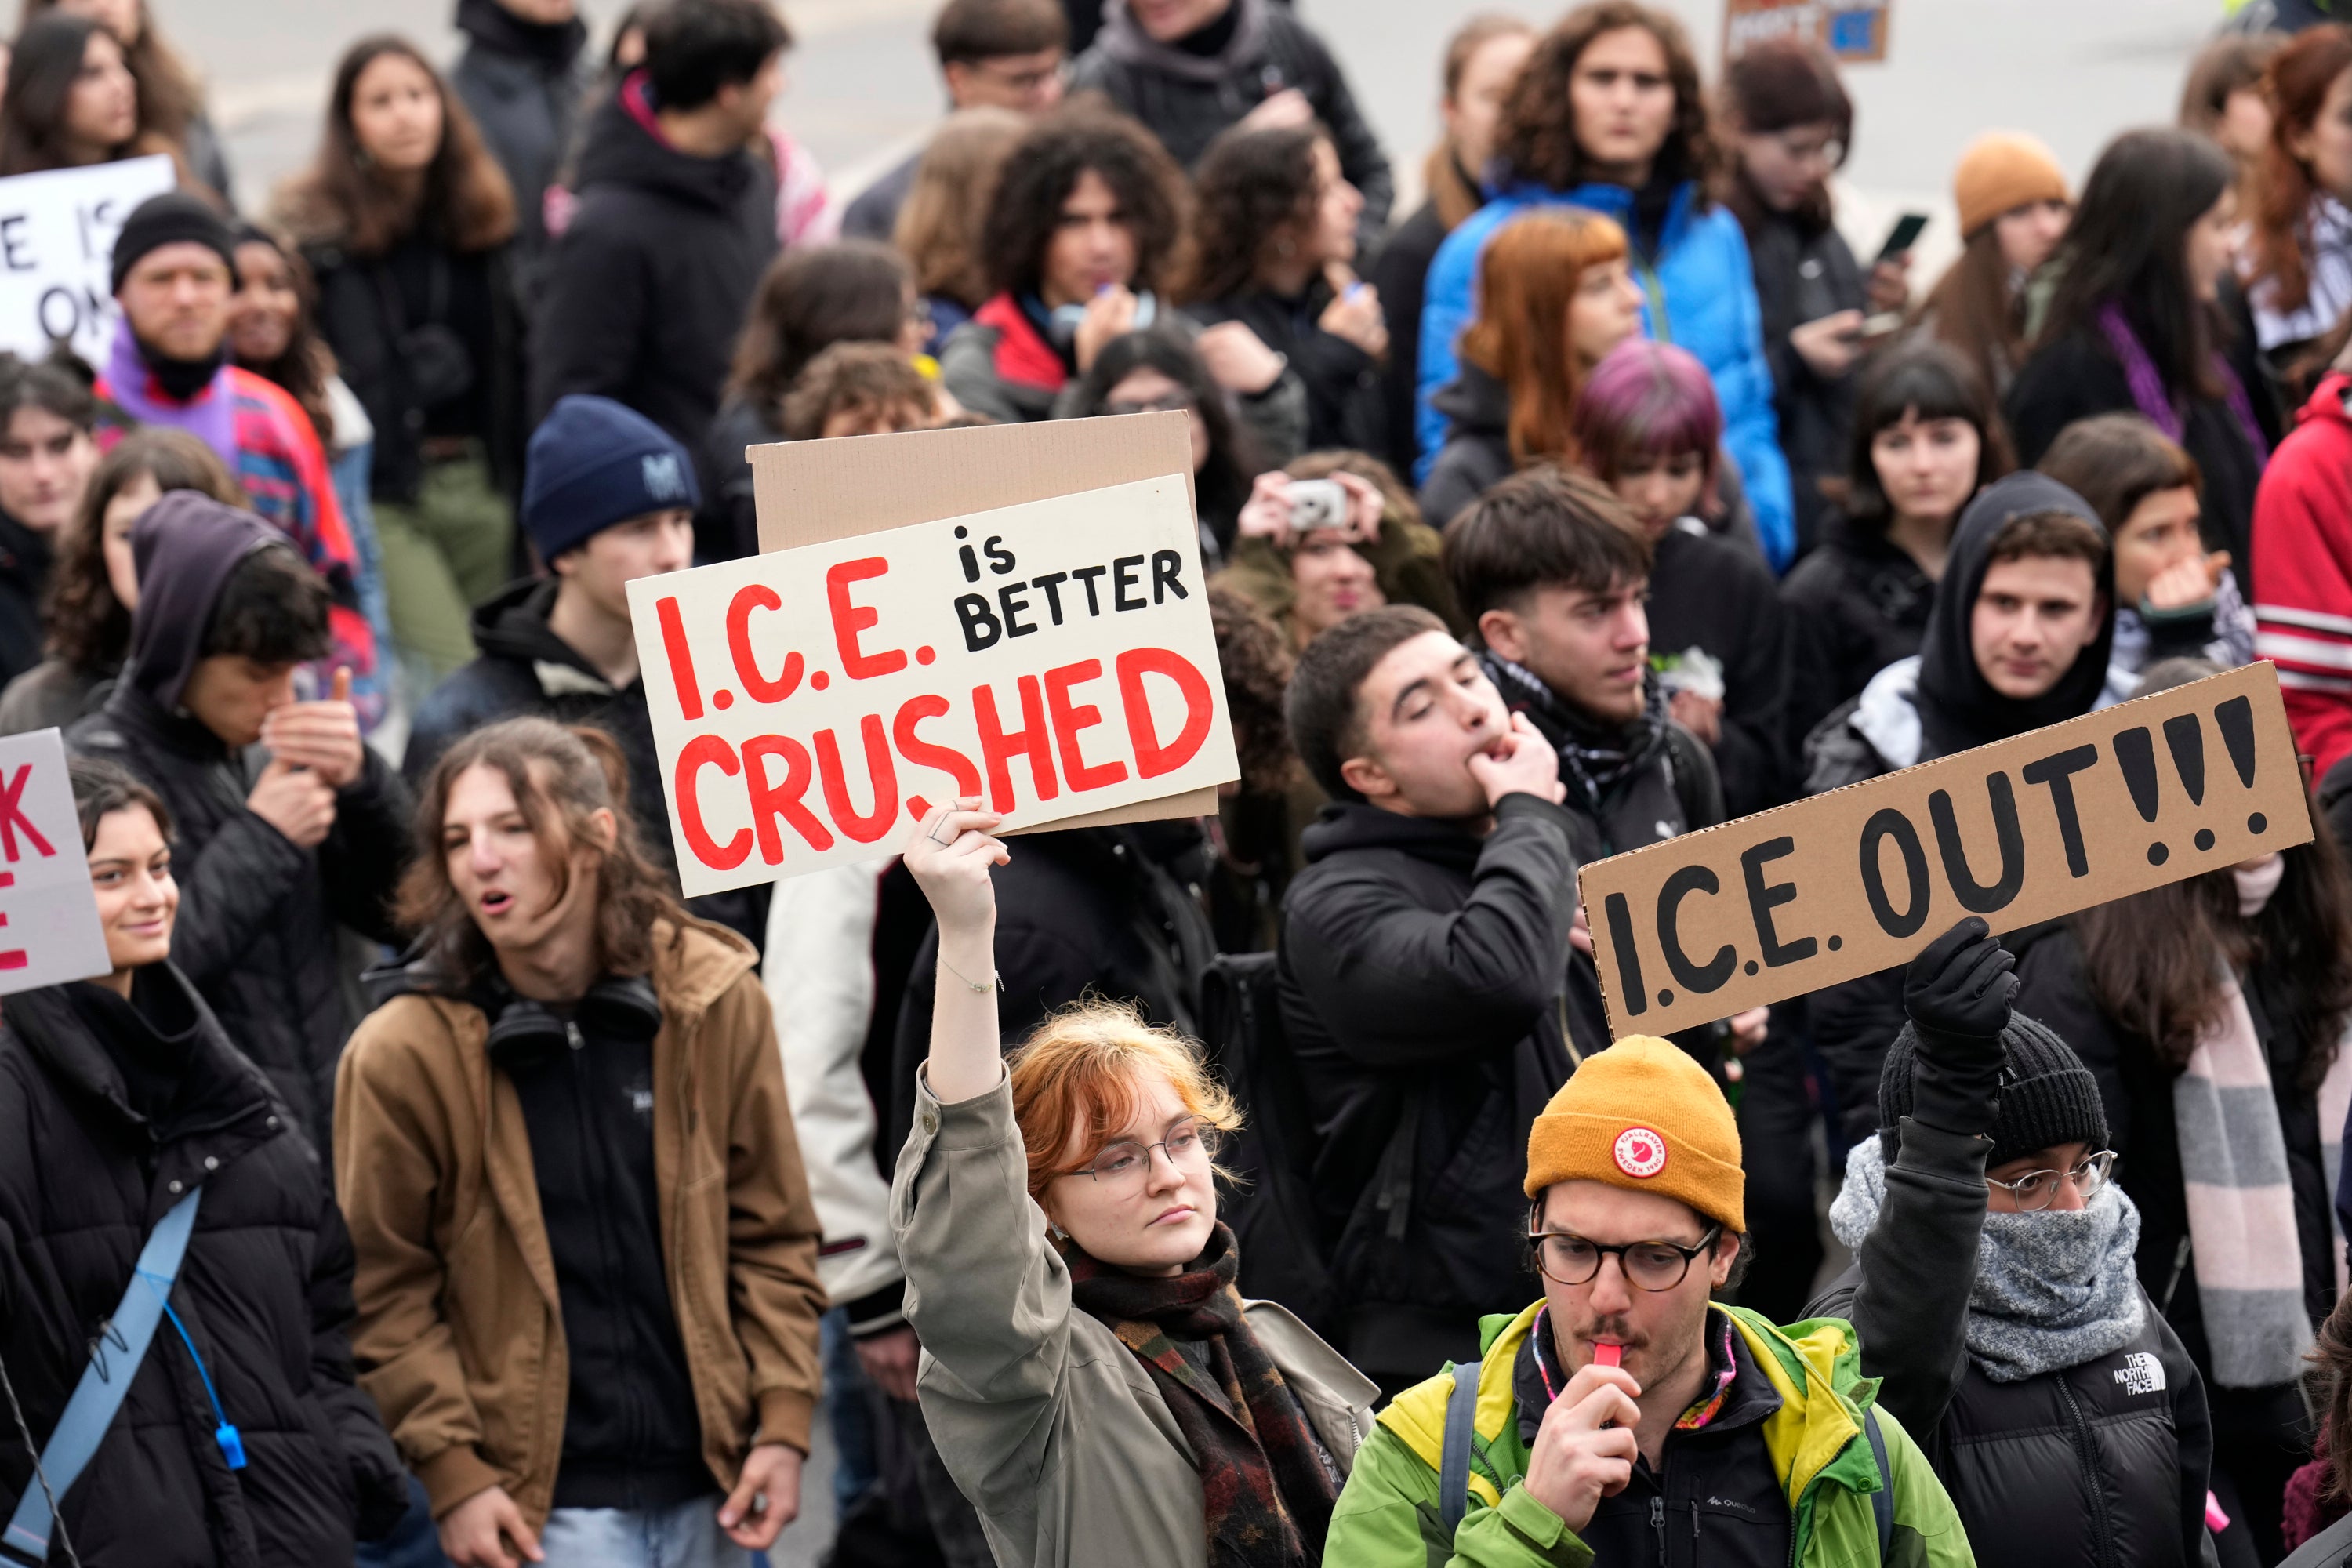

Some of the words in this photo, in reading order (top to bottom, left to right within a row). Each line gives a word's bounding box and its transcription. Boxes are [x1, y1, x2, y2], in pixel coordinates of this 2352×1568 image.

[954, 549, 1189, 652] BETTER
[657, 557, 935, 720] I.C.E.
[676, 648, 1213, 871] CRUSHED
[1605, 836, 1842, 1017] I.C.E.
[1859, 695, 2268, 938] OUT!!!
[1617, 1148, 1643, 1173] SWEDEN
[2125, 1352, 2147, 1368] THE
[2113, 1365, 2151, 1385] NORTH
[2126, 1379, 2152, 1396] FACE
[1724, 1500, 1755, 1514] Quechua
